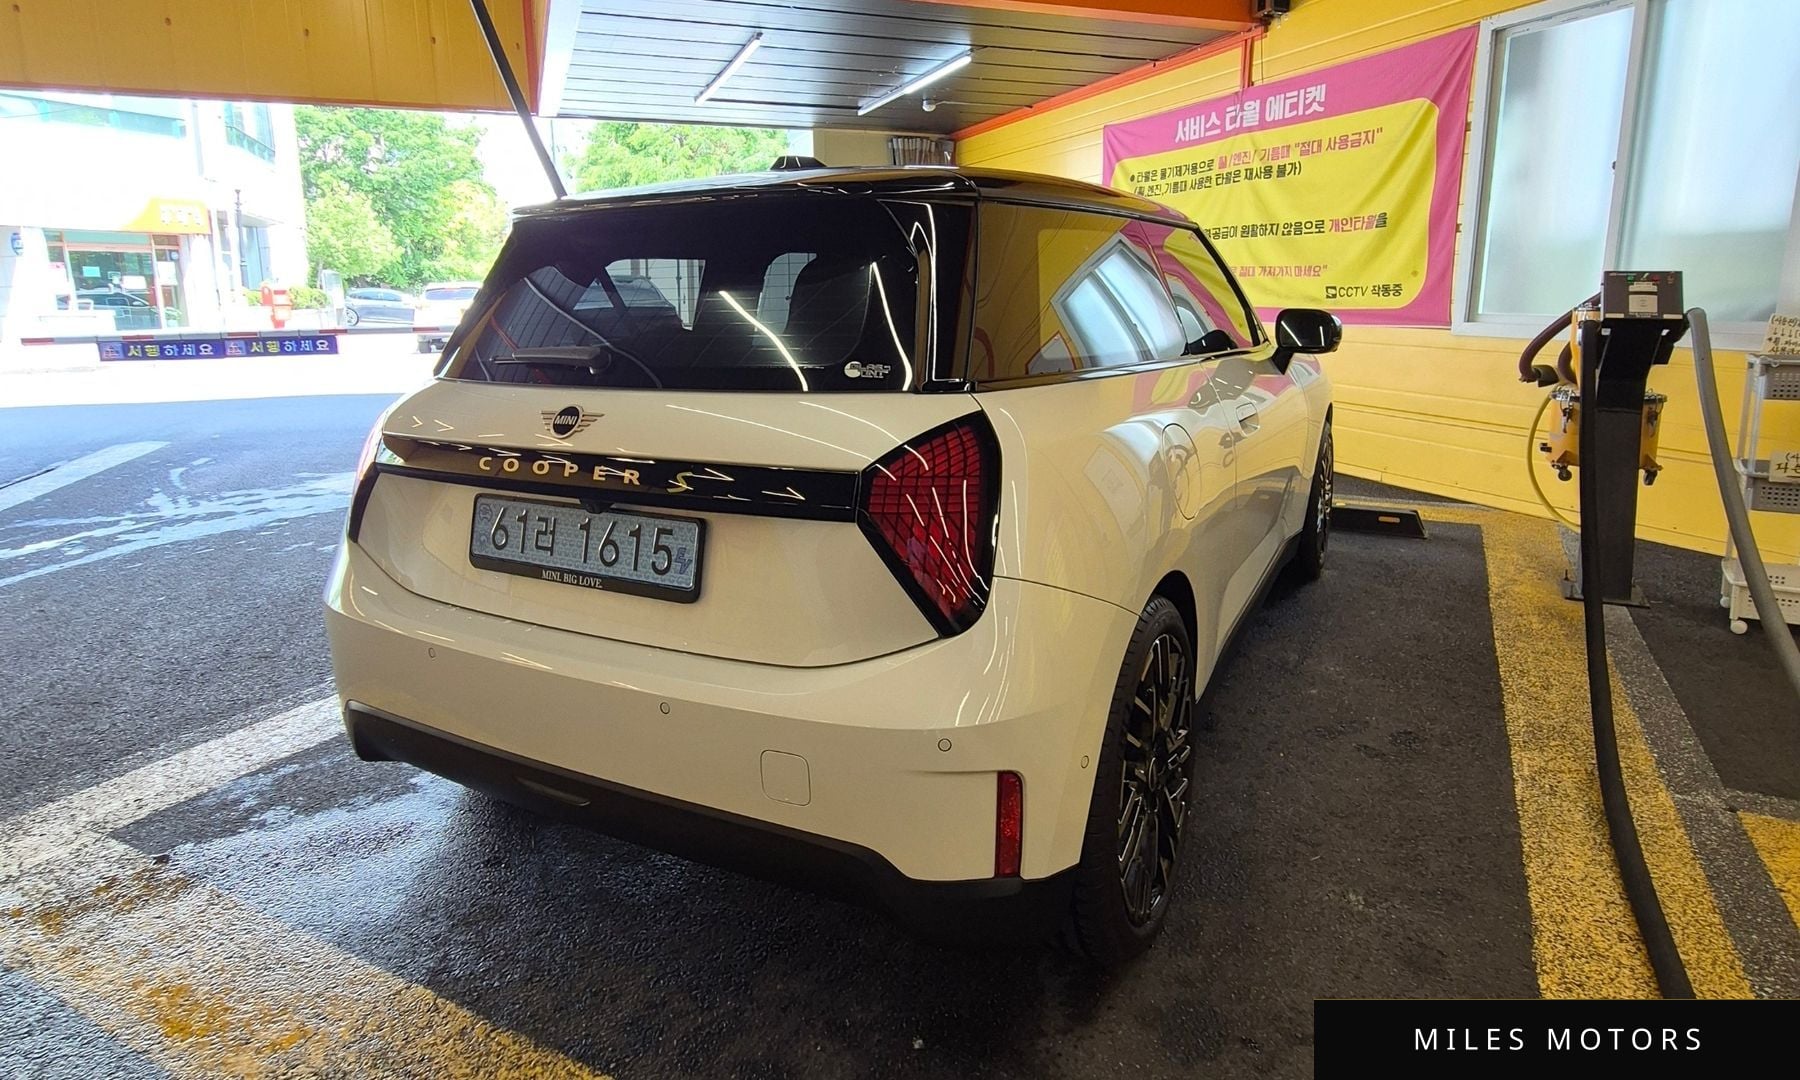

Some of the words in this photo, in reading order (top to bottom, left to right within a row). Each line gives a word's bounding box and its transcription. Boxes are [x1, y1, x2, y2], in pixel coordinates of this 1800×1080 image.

[1175, 112, 1221, 143] 서비스
[1226, 99, 1260, 131] 타월
[1265, 84, 1326, 121] 에티켓
[1137, 169, 1158, 183] 타월은
[1160, 159, 1215, 180] 물기제거용으로
[1325, 127, 1383, 151] 사용금지"
[1189, 175, 1212, 190] 사용한
[1215, 169, 1241, 186] 타월은
[1243, 164, 1273, 181] 재사용
[1276, 160, 1302, 178] 불가)
[1240, 222, 1280, 238] 원활하지
[1282, 219, 1325, 236] 않음으로
[1328, 212, 1388, 233] 개인타월을
[1338, 286, 1368, 298] CCTV
[1370, 283, 1403, 297] 작동중
[128, 343, 214, 357] 서행하세요
[250, 339, 329, 353] 서행하세요
[554, 414, 578, 426] MINI
[479, 456, 641, 486] COOPER
[665, 471, 693, 493] S
[491, 507, 557, 557] 61러
[578, 517, 674, 576] 1615
[674, 547, 693, 575] EV
[563, 573, 578, 585] BIG
